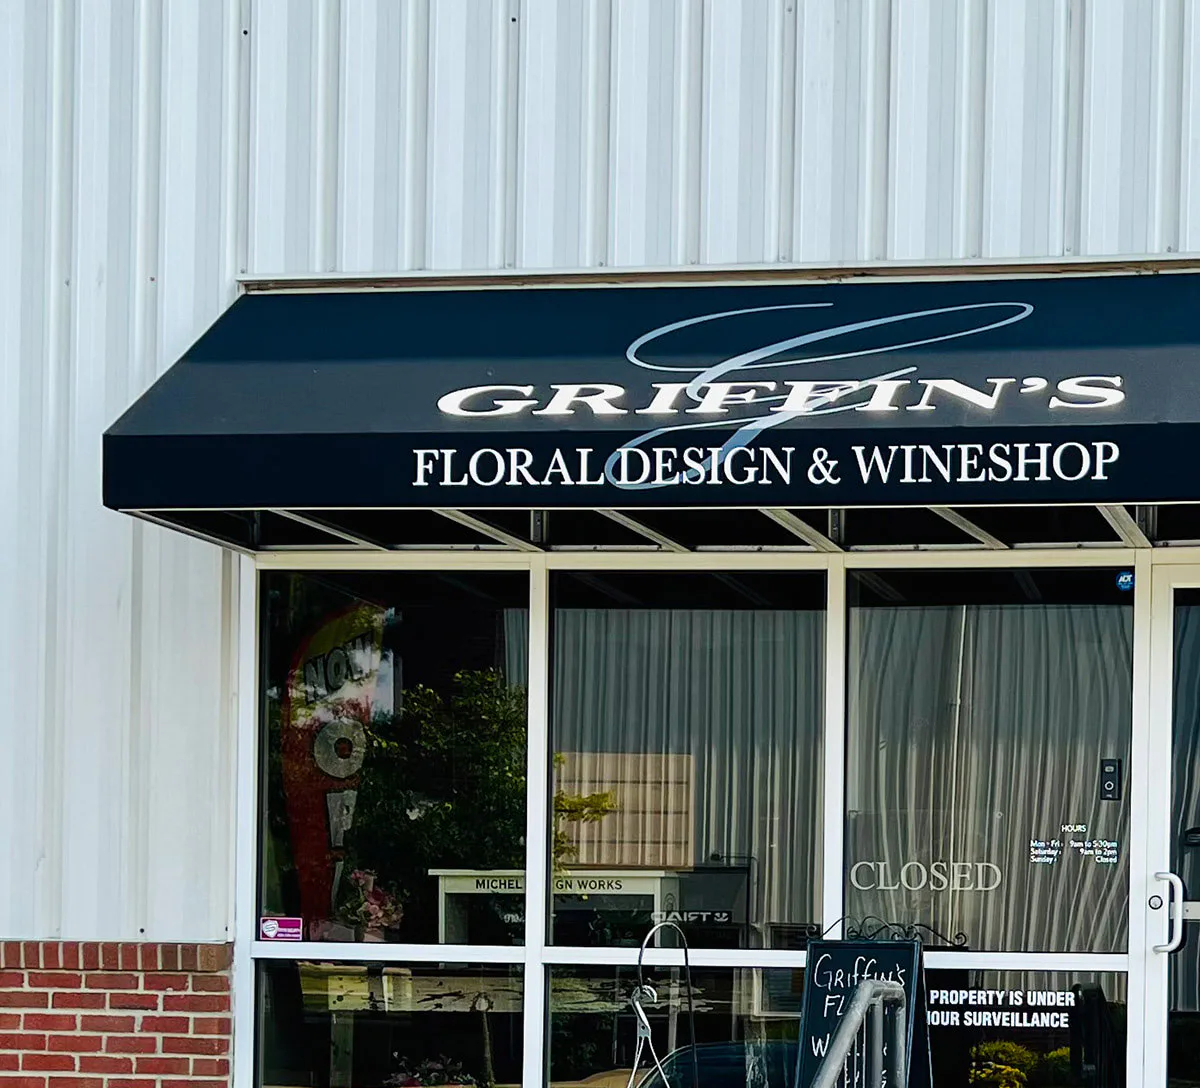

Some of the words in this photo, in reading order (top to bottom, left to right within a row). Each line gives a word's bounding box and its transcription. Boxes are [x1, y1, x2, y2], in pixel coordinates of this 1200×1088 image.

[436, 375, 1127, 418] GRIFFIN'S
[412, 447, 604, 487] FLORAL
[616, 446, 795, 486] DESIGN
[807, 446, 840, 485] &
[852, 441, 1120, 484] WINESHOP
[1061, 824, 1087, 833] HOURS
[1030, 839, 1046, 848] Mon
[475, 878, 523, 890] MICHEL
[850, 861, 1002, 891] CLOSED
[577, 879, 623, 891] WORKS
[929, 989, 1005, 1005] PROPERTY
[1009, 990, 1023, 1006] IS
[1027, 990, 1075, 1007] UNDER
[963, 1011, 1069, 1028] SURVEILLANCE
